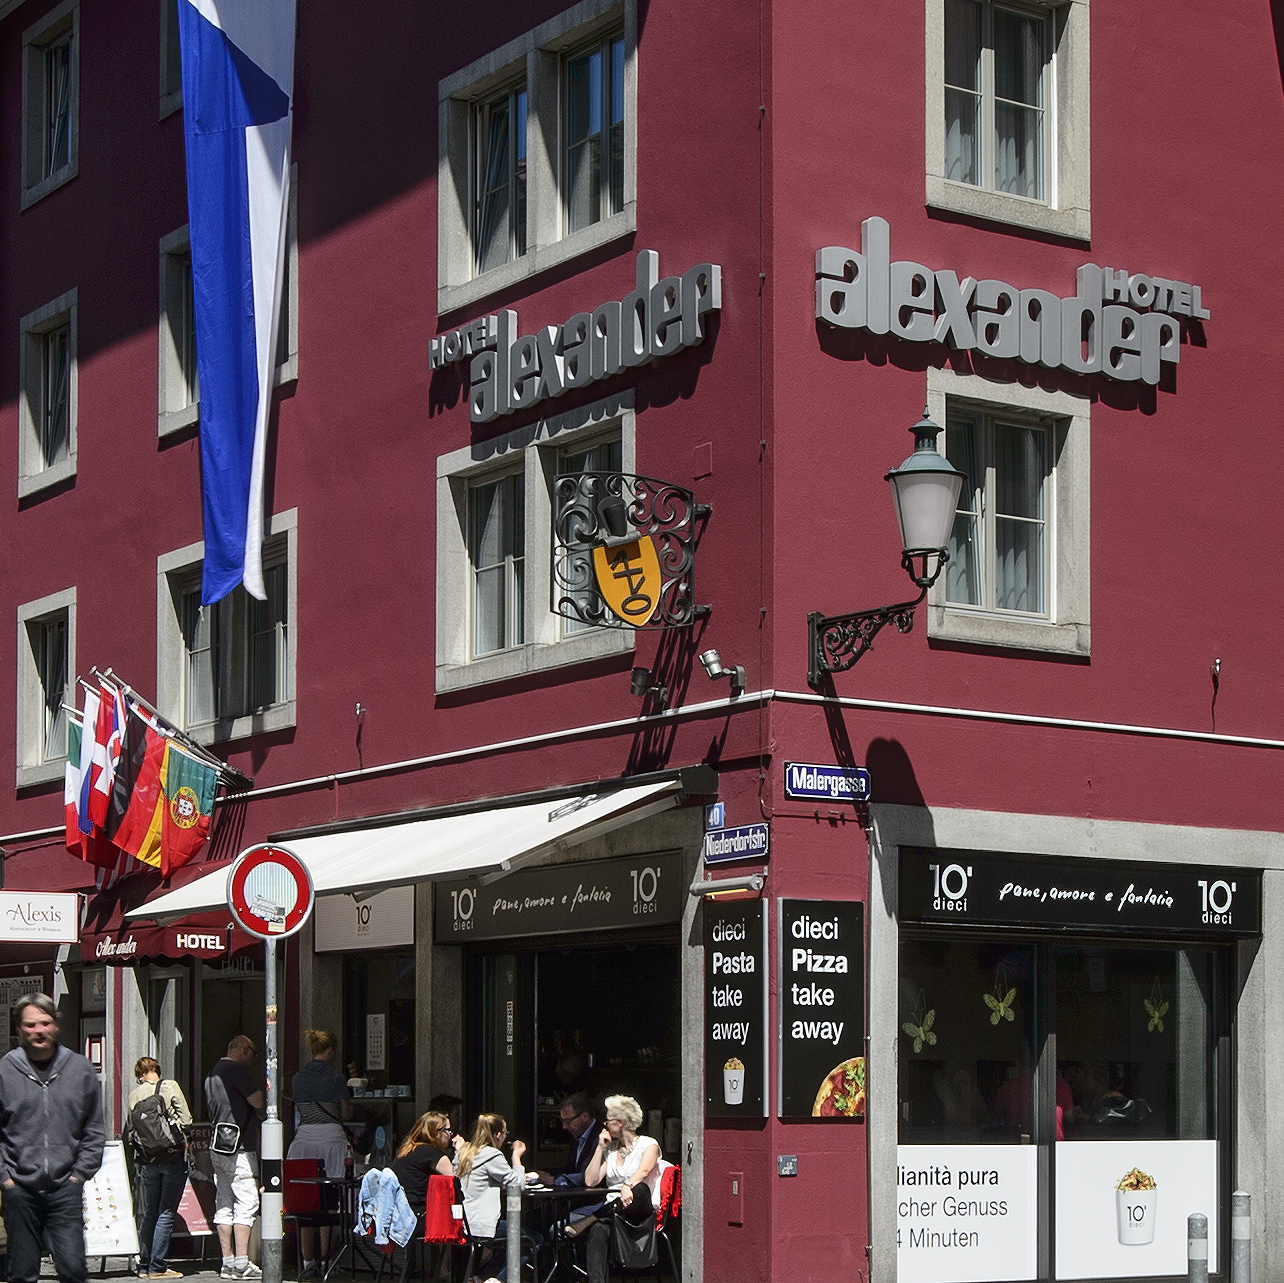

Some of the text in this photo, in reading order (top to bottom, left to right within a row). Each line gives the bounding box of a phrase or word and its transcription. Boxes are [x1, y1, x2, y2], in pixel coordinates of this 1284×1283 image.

[815, 216, 1181, 384] alexander
[1103, 265, 1211, 320] HOTEL
[428, 311, 498, 371] HOTEL
[469, 249, 722, 423] alexander
[792, 766, 866, 797] Malergasse
[708, 807, 720, 826] 40
[706, 828, 766, 856] Niederdorfstr.
[630, 867, 661, 902] 10'
[929, 863, 973, 900] 10'
[450, 888, 477, 920] 10'
[561, 894, 567, 904] e
[633, 900, 658, 914] dieci
[933, 897, 968, 912] dieci
[1105, 892, 1113, 902] e
[1197, 880, 1237, 914] 10'
[5, 901, 62, 926] Alexis
[453, 919, 474, 932] dieci
[1202, 911, 1233, 925] dieci
[712, 917, 746, 942] dieci
[791, 915, 839, 940] dieci
[176, 933, 225, 951] HOTEL
[712, 951, 755, 975] Pasta
[792, 948, 848, 974] Pizza
[711, 984, 743, 1008] take
[791, 982, 835, 1007] take
[712, 1021, 750, 1046] away
[791, 1020, 844, 1046] away
[957, 1168, 999, 1190] pura
[898, 1196, 1008, 1217] cher Genuss
[1126, 1204, 1147, 1222] 10'
[909, 1228, 979, 1248] Minuten
